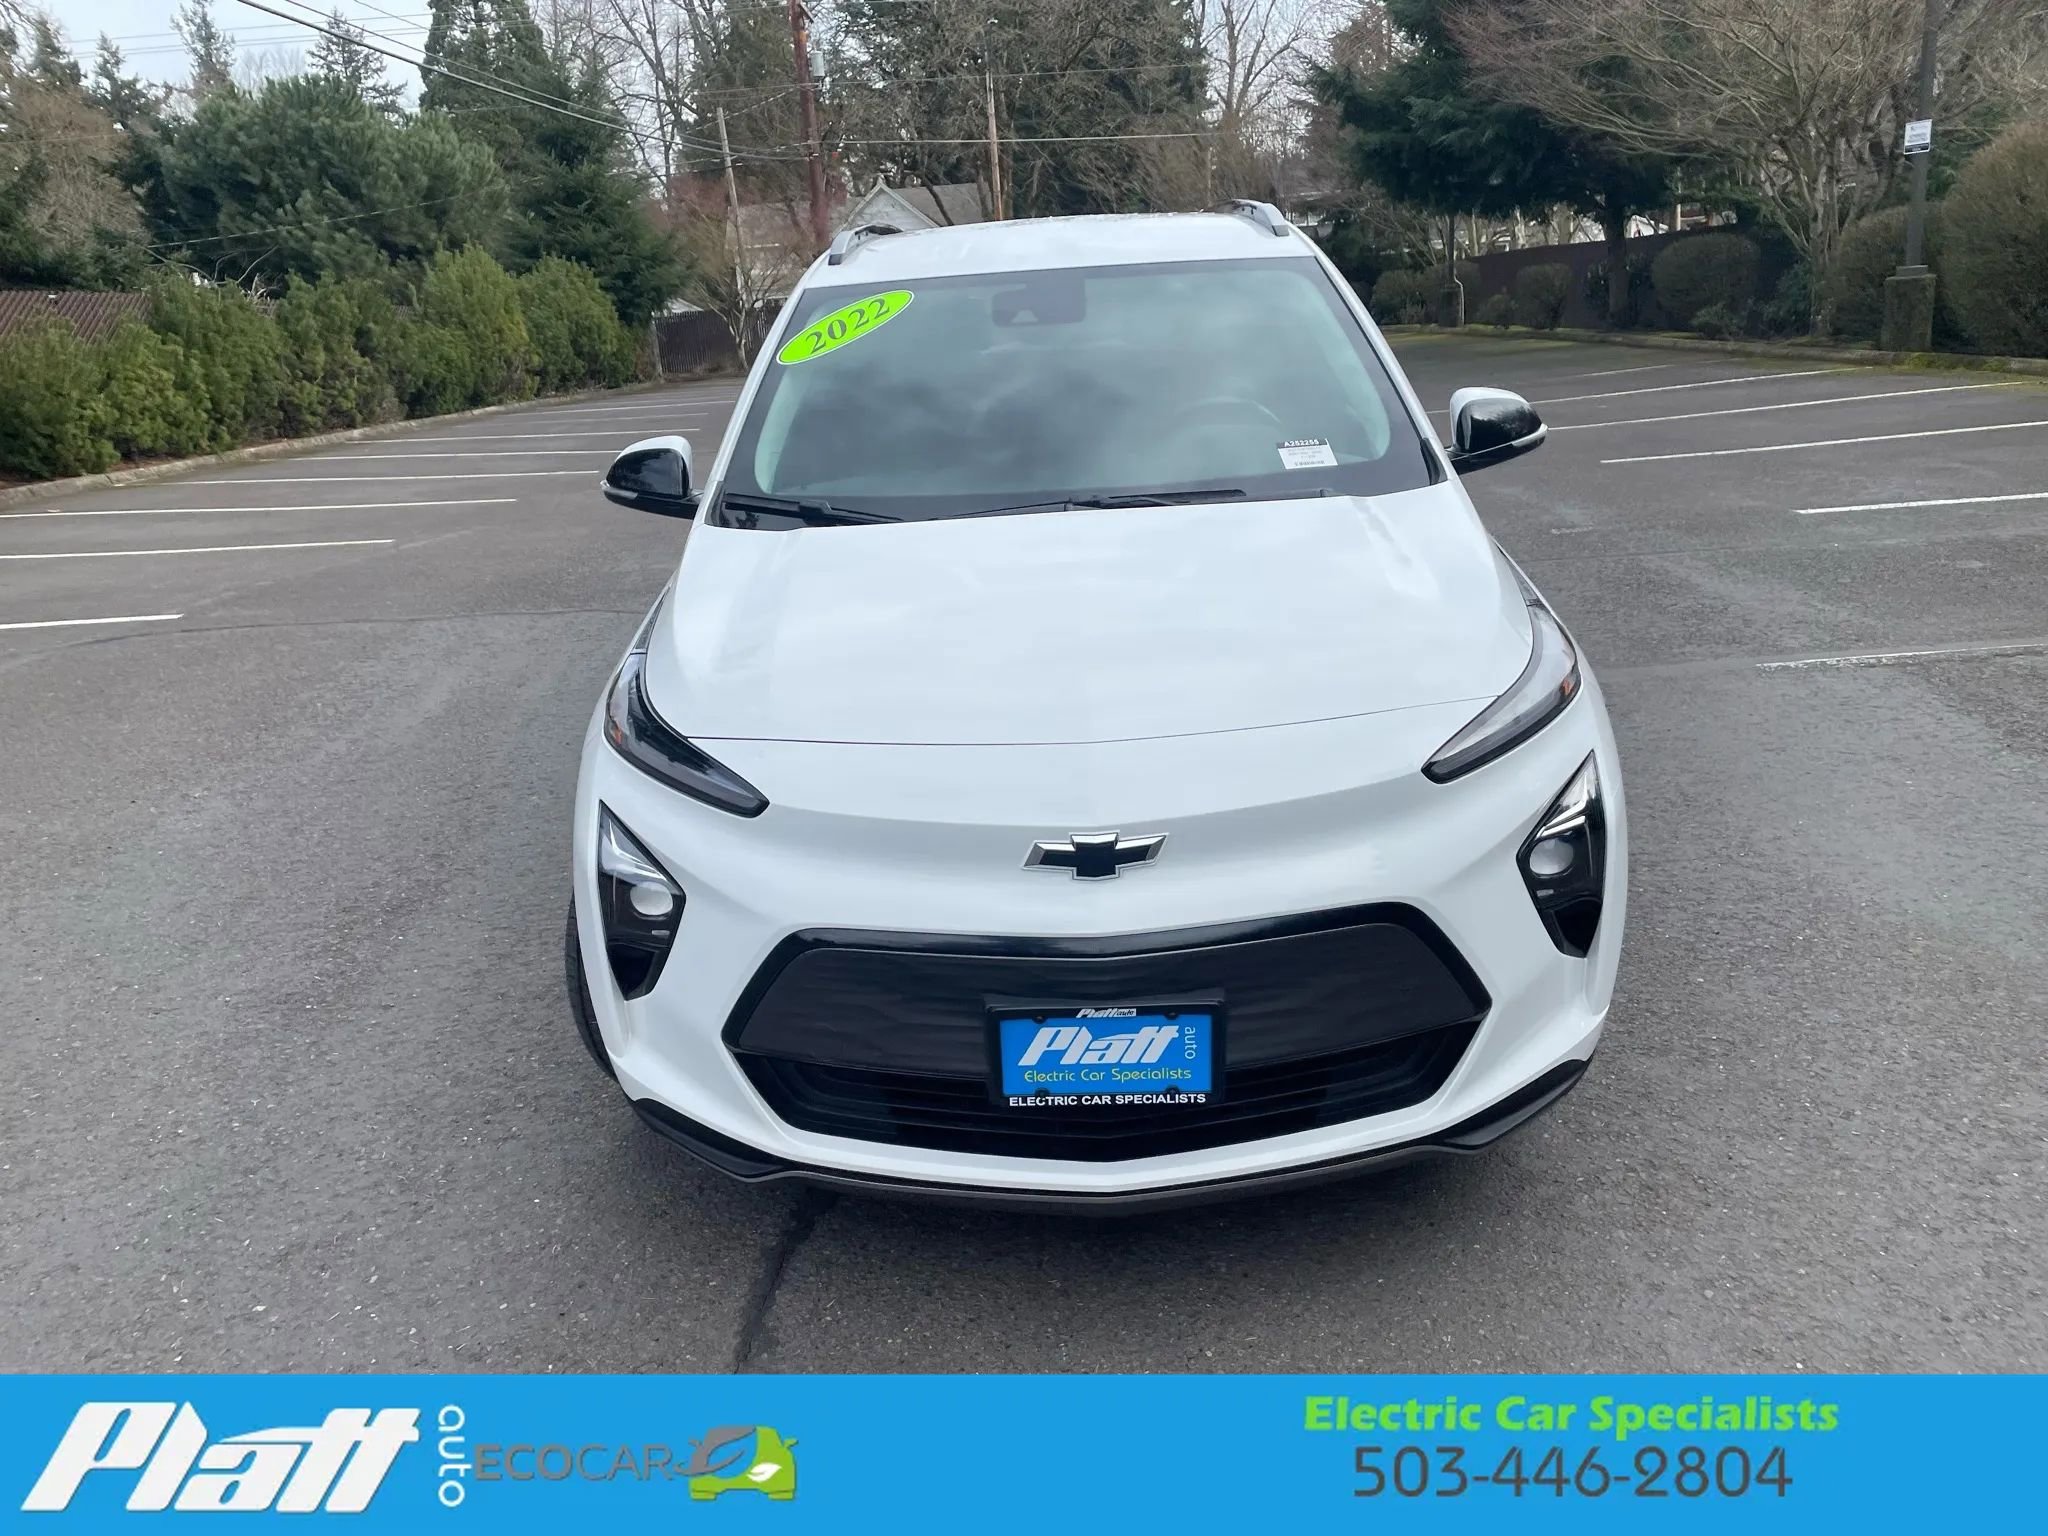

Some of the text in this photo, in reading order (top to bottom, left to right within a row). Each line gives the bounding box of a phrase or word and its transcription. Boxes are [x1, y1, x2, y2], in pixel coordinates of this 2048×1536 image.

[806, 298, 890, 354] 2022
[1018, 1025, 1179, 1066] Platt
[1184, 1026, 1196, 1060] auto
[1024, 1068, 1192, 1083] Electric Car Specialists
[1009, 1093, 1207, 1107] ELECTRIC CAR SPECIALISTS
